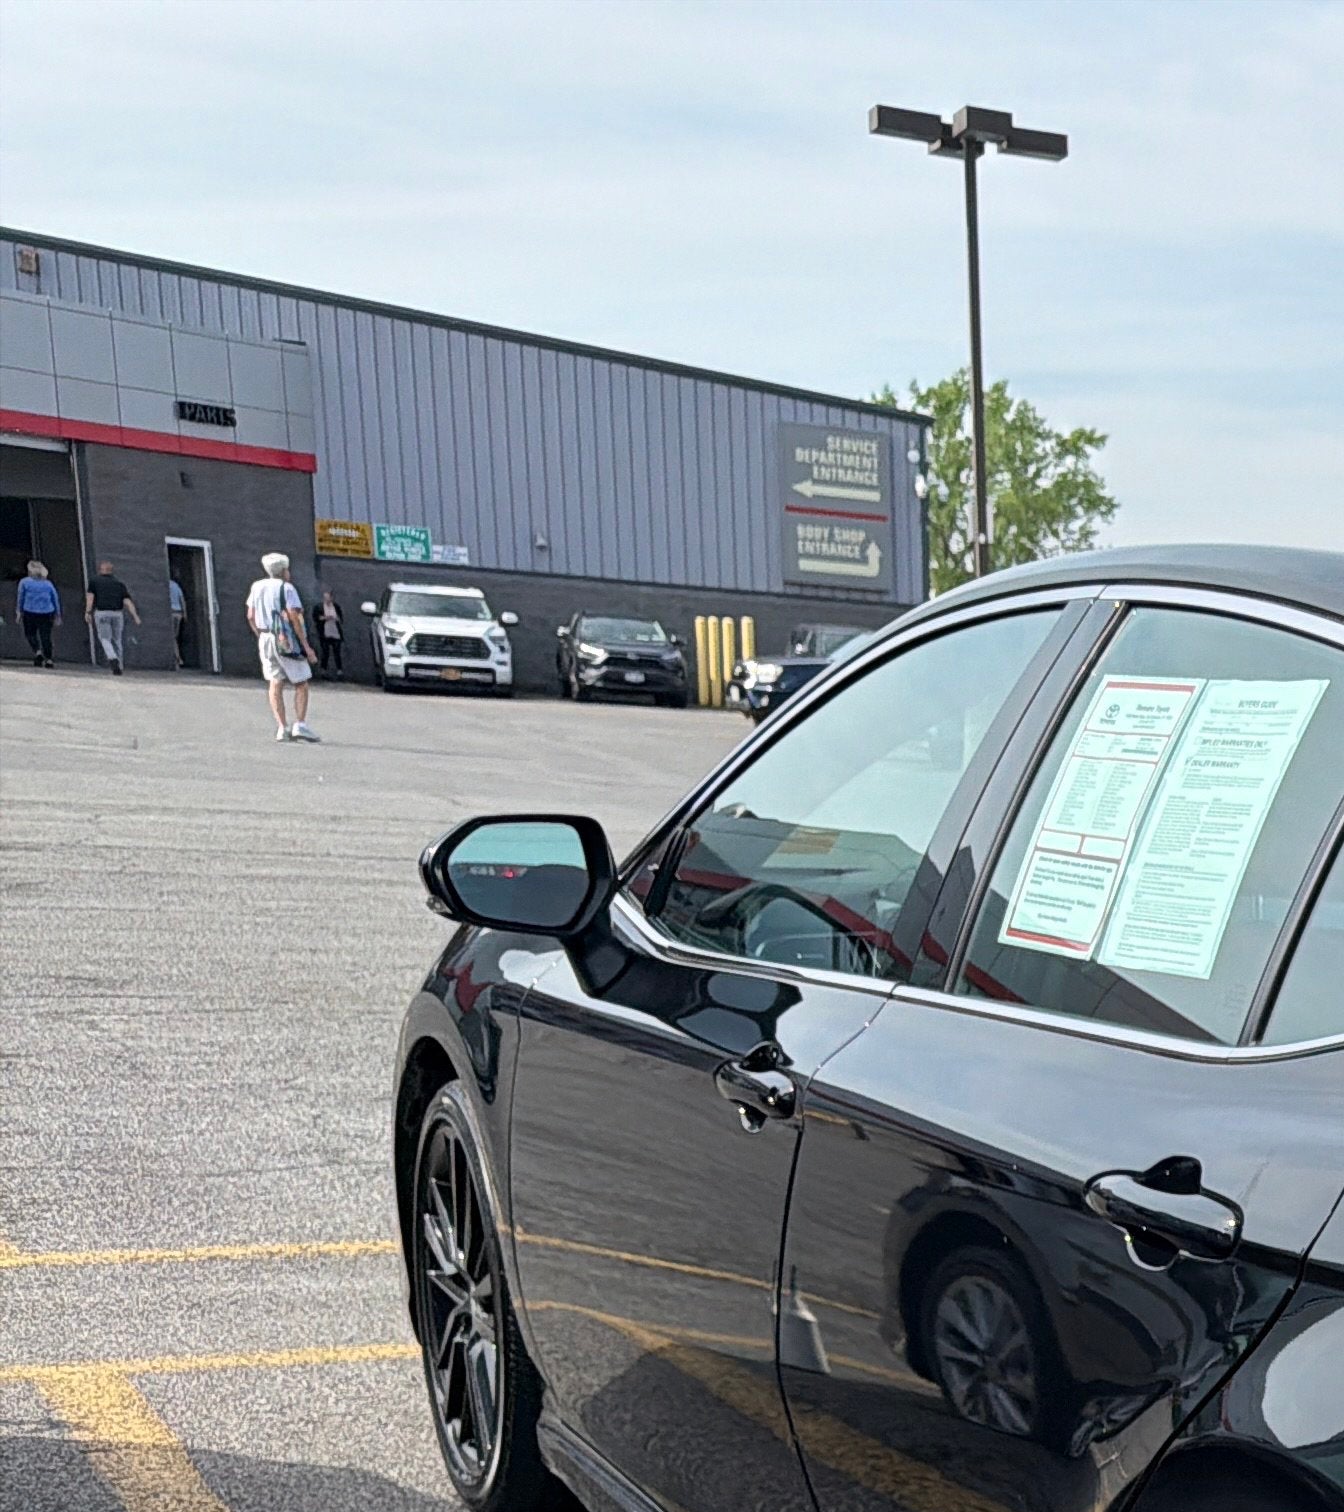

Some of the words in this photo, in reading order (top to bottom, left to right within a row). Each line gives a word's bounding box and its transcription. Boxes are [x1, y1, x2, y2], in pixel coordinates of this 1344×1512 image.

[826, 435, 878, 453] SERVICE
[795, 448, 878, 468] DEPARTMENT
[813, 465, 879, 485] ENTRANCE
[796, 523, 830, 541] BODY
[834, 526, 866, 544] SHOP
[797, 540, 861, 558] ENTRANCE
